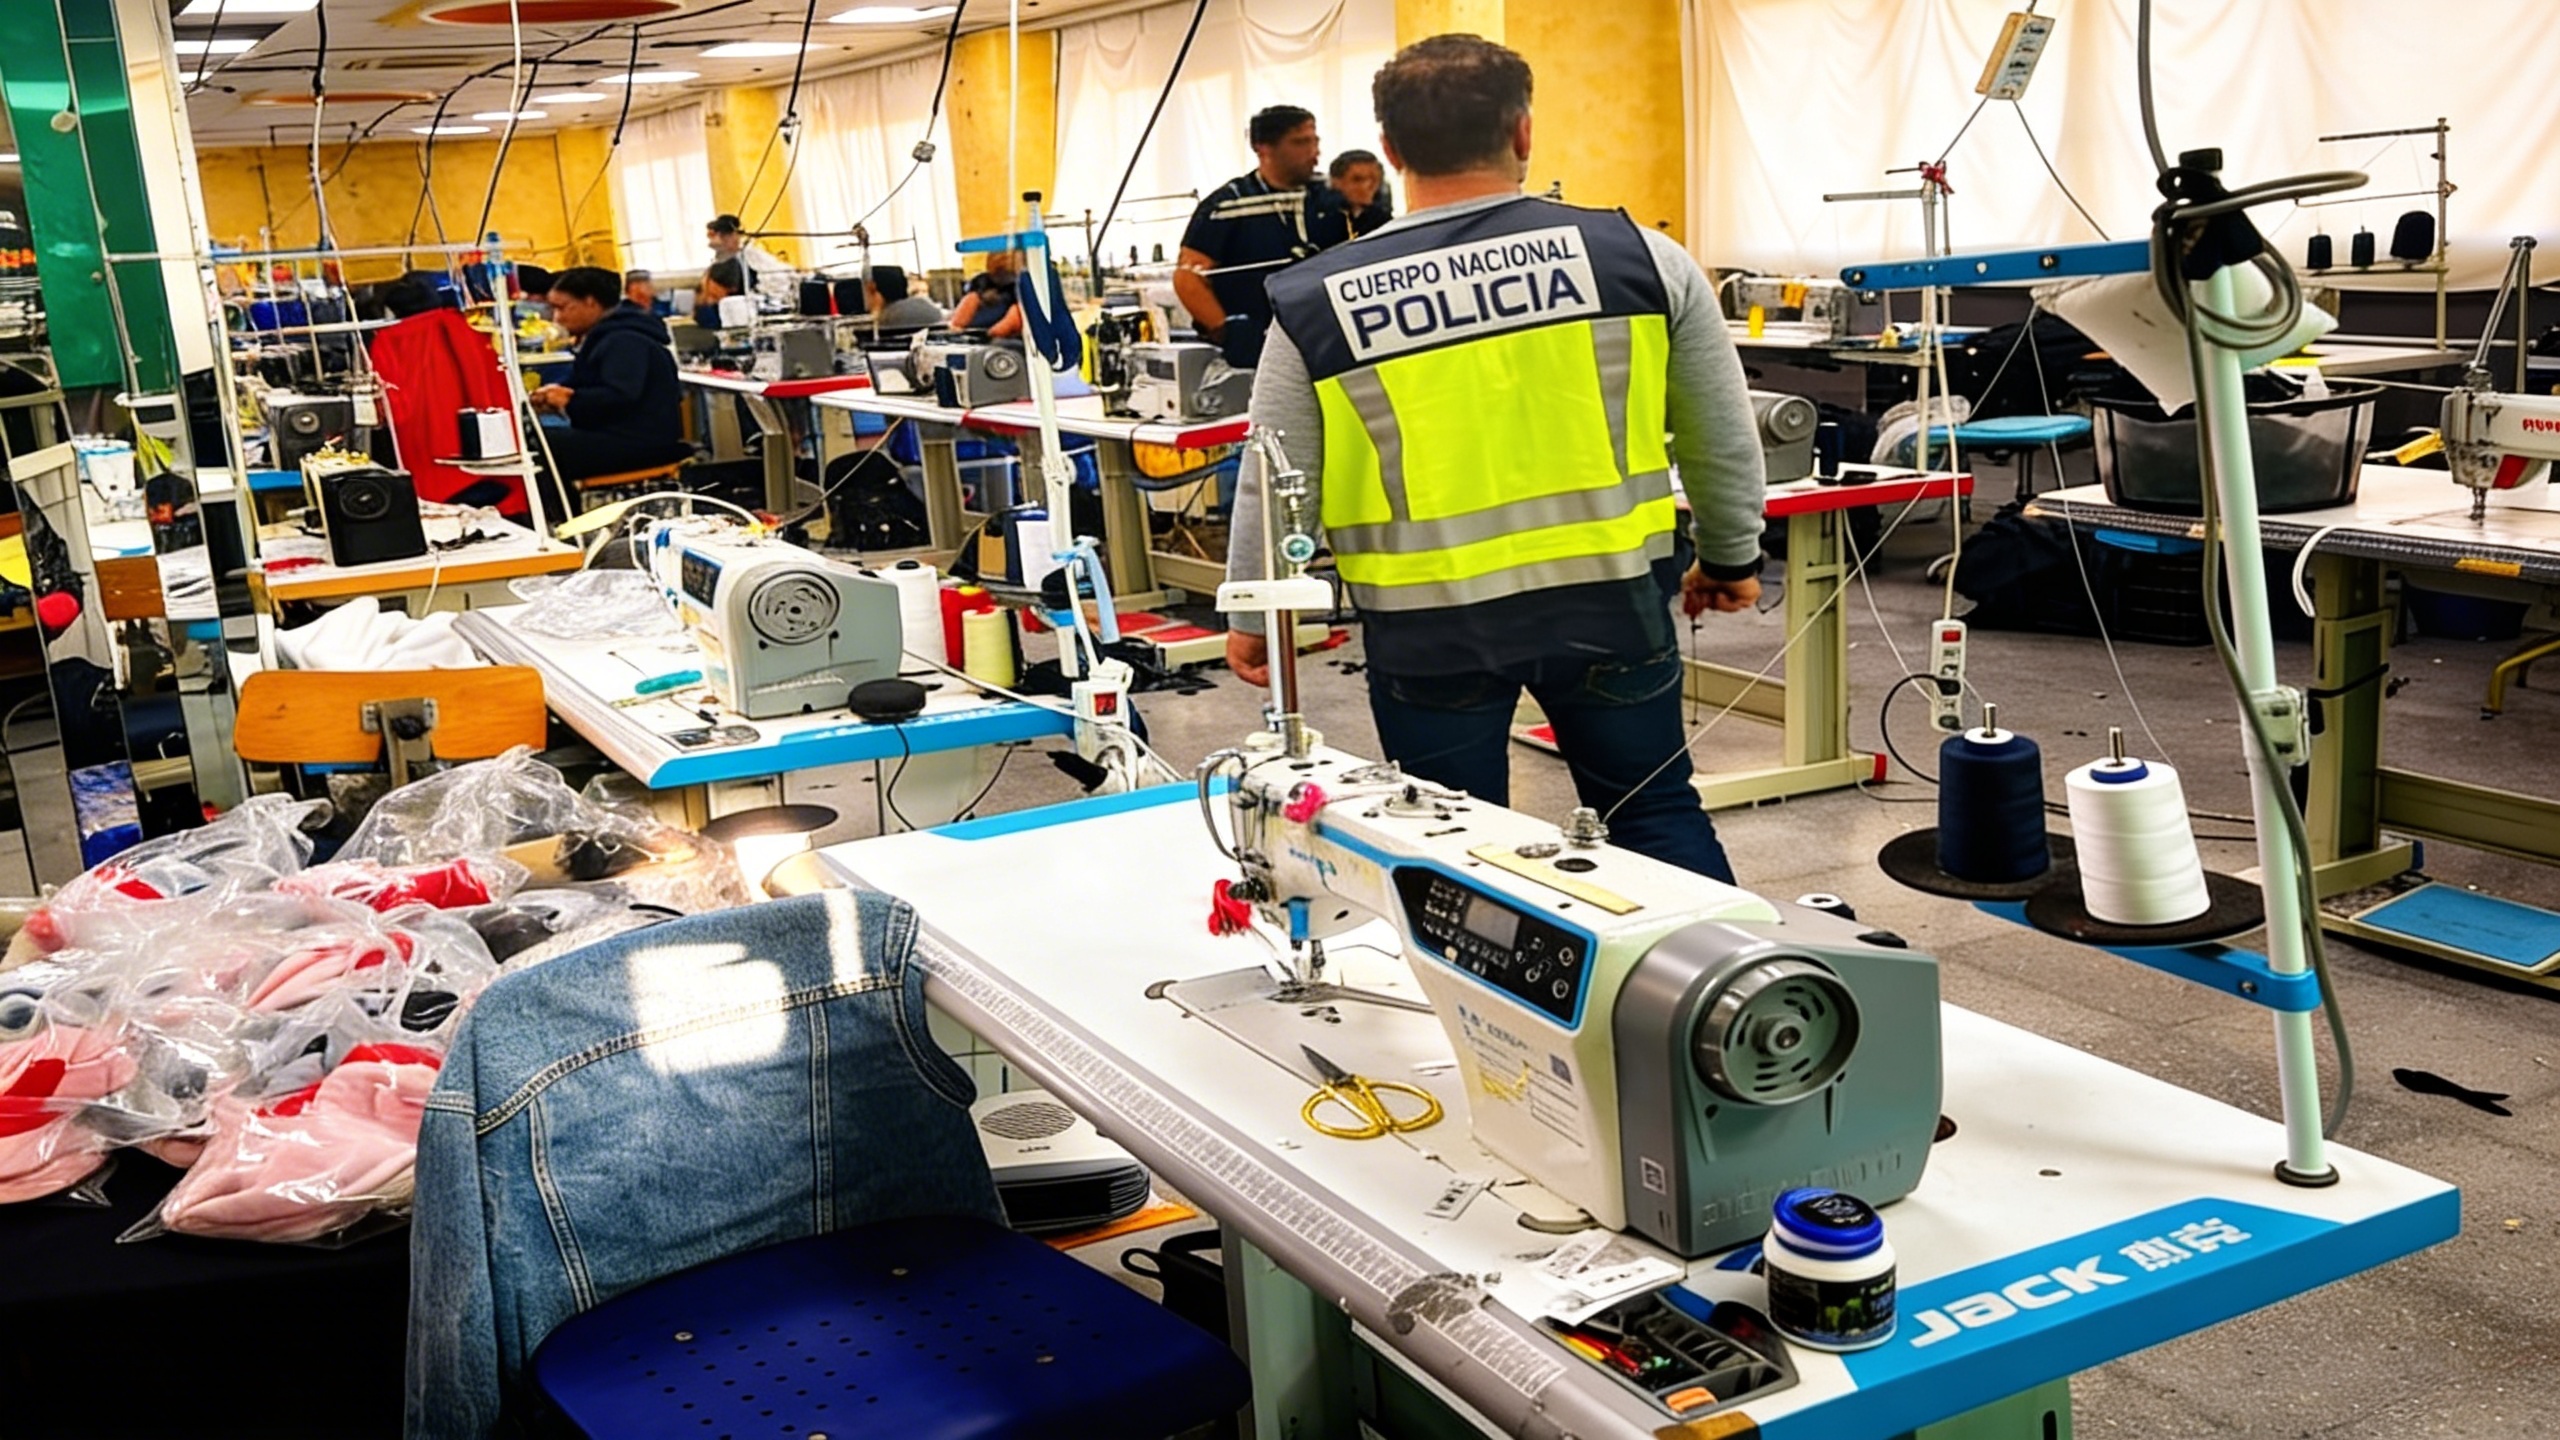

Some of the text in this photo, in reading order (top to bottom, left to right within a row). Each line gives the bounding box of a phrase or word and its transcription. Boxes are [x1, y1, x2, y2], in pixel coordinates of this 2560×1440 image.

[1340, 236, 1578, 302] CUERPO NACIONAL
[1351, 268, 1586, 349] POLICIA
